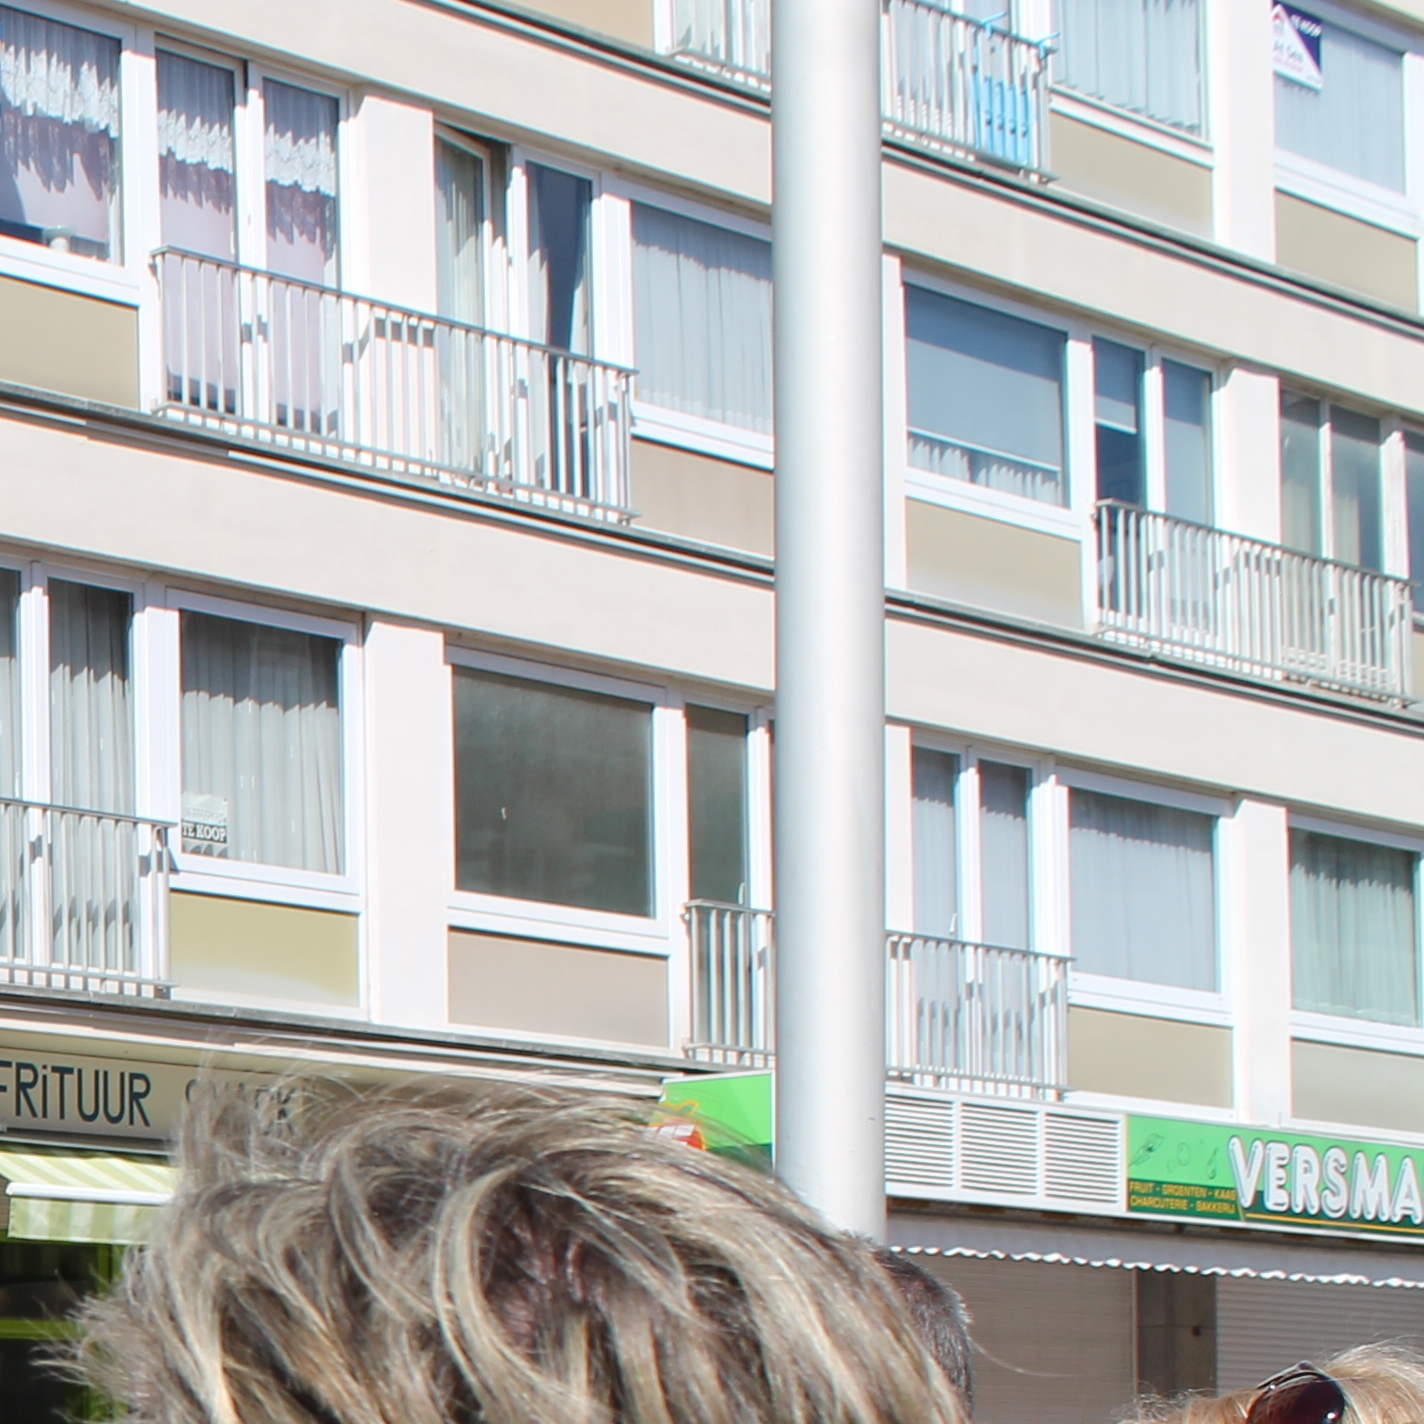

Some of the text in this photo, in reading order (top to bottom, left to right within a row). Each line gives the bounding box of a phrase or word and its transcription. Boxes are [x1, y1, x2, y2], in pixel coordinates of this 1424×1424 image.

[183, 822, 227, 842] TE KOOP
[1130, 1180, 1155, 1194] FRUIT
[1162, 1183, 1209, 1198] GROENTEN
[1228, 1133, 1424, 1226] VERSMA
[1130, 1194, 1236, 1215] CHARCUTERIE BAKKERIJ
